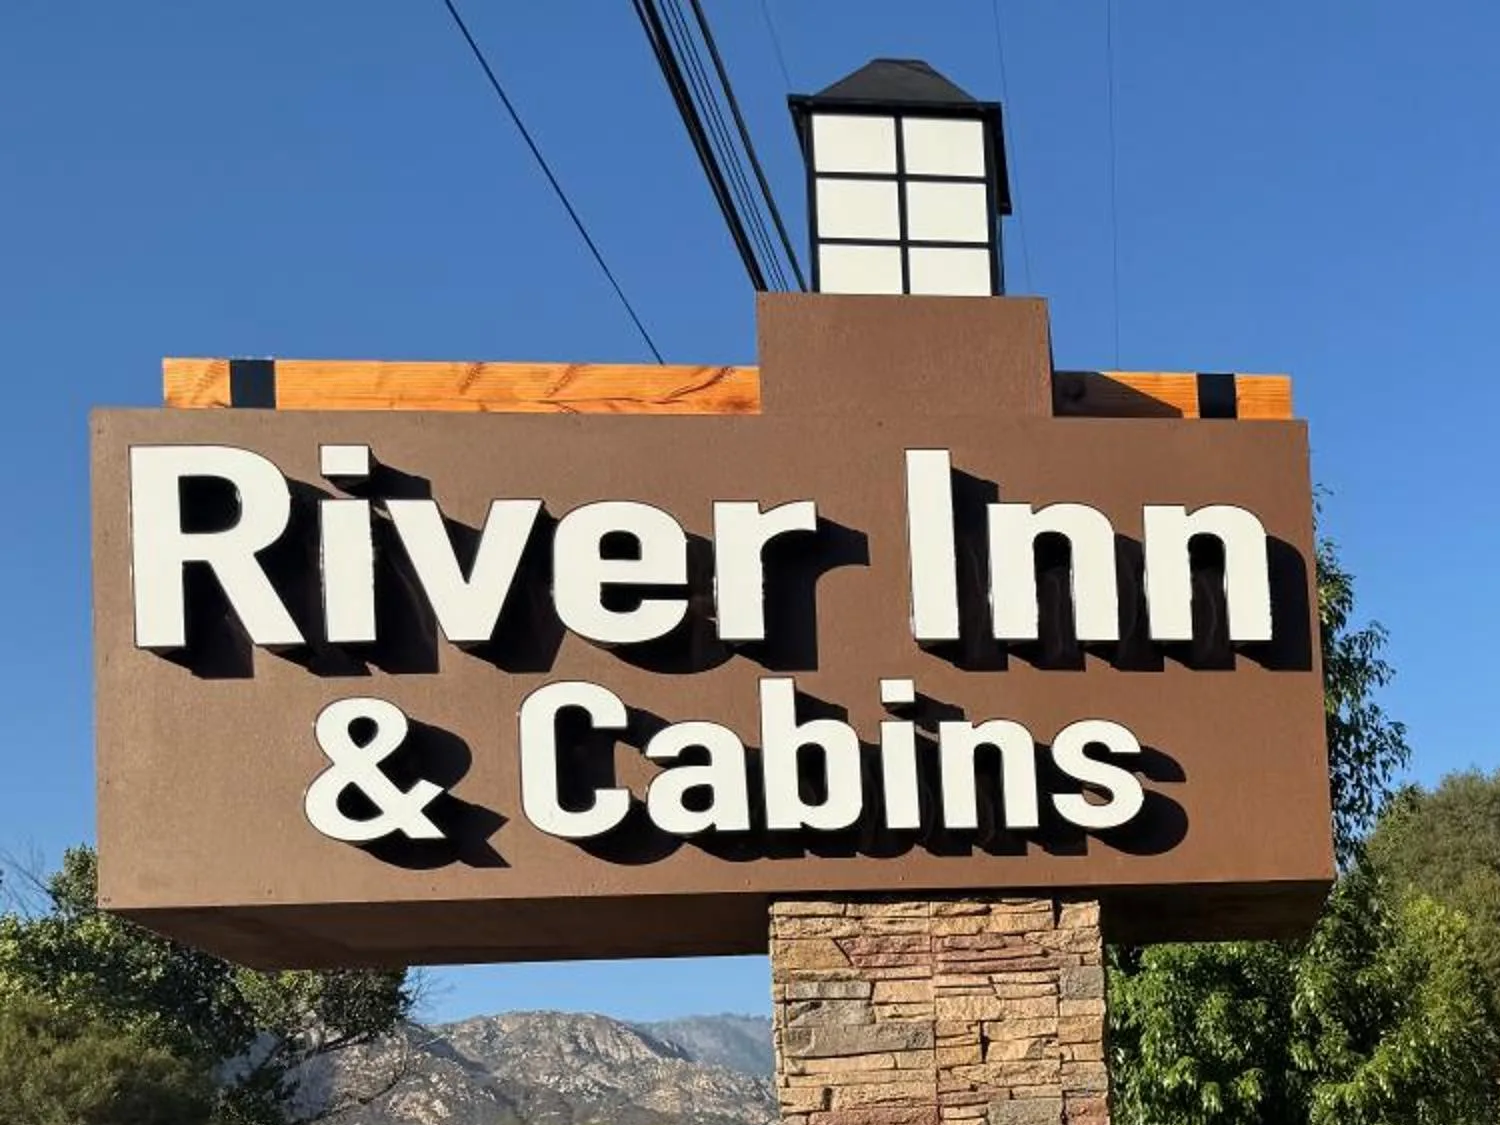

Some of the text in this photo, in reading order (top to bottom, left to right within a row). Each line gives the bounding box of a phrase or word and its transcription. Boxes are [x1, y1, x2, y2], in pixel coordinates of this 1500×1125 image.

[130, 445, 1275, 648] River Inn
[304, 677, 1146, 842] & Cabins
